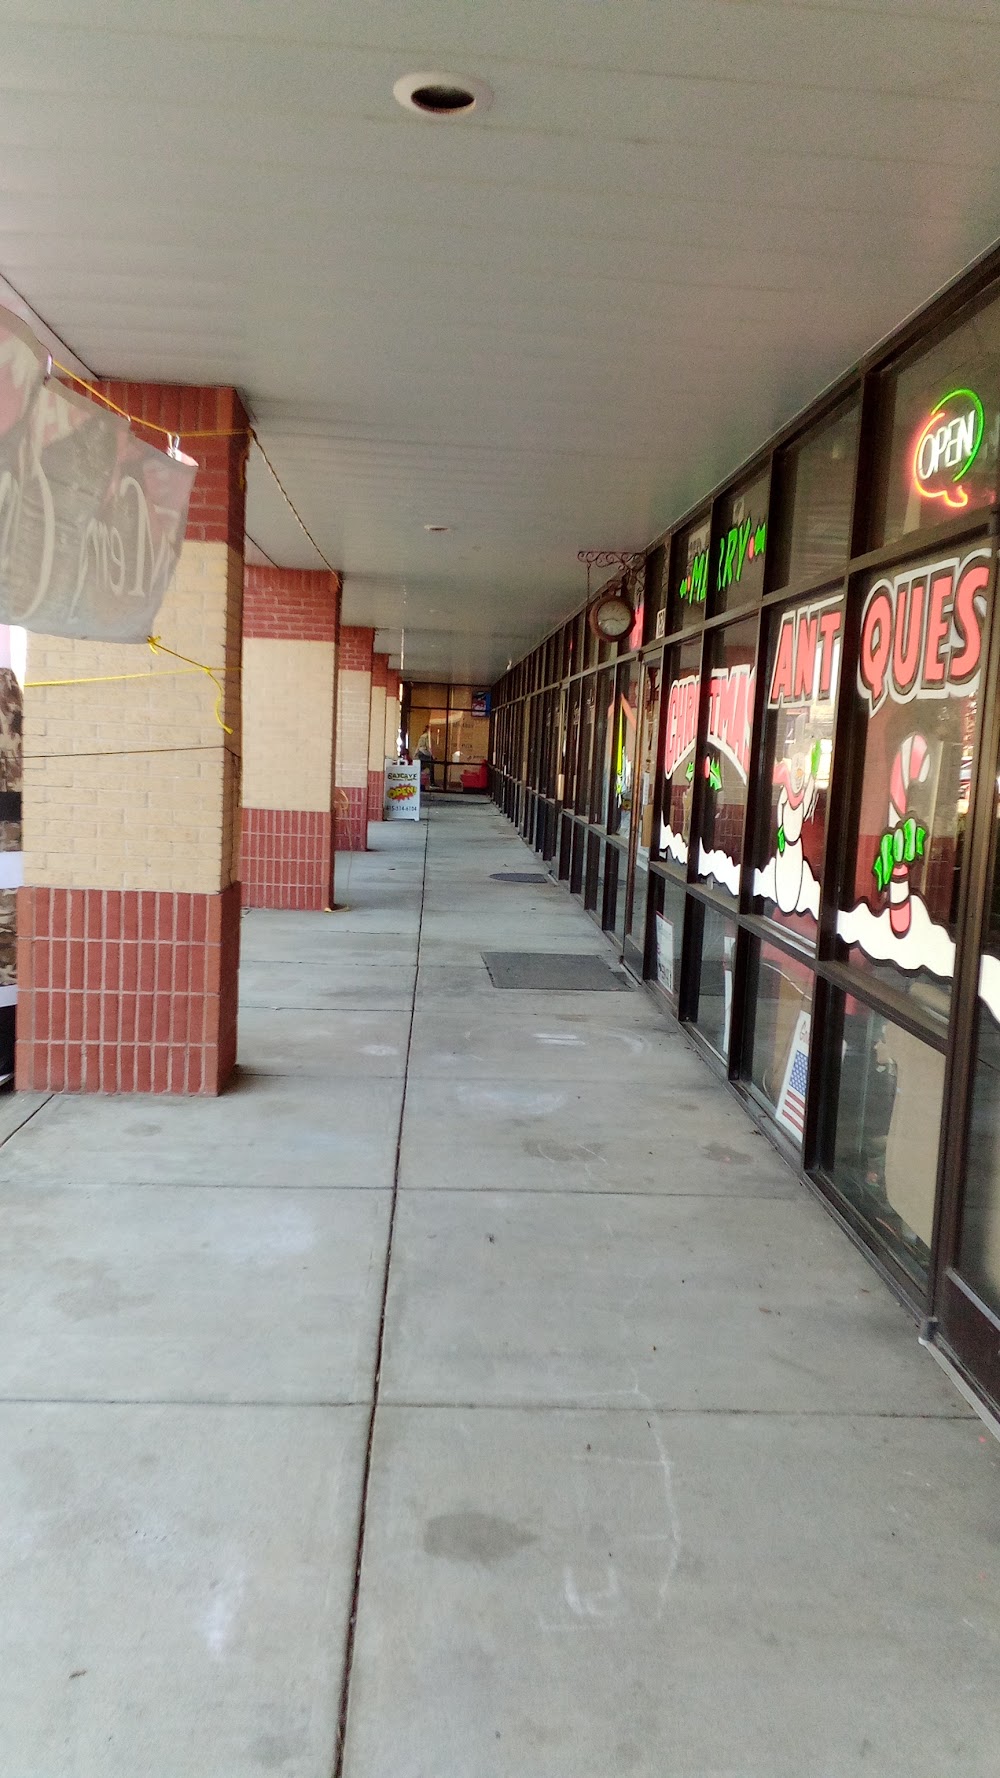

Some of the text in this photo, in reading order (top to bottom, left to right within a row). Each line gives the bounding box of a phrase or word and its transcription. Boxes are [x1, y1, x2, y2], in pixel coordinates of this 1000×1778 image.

[917, 409, 976, 481] OPEN
[688, 517, 751, 606] MRY
[768, 550, 992, 716] ANTQUES
